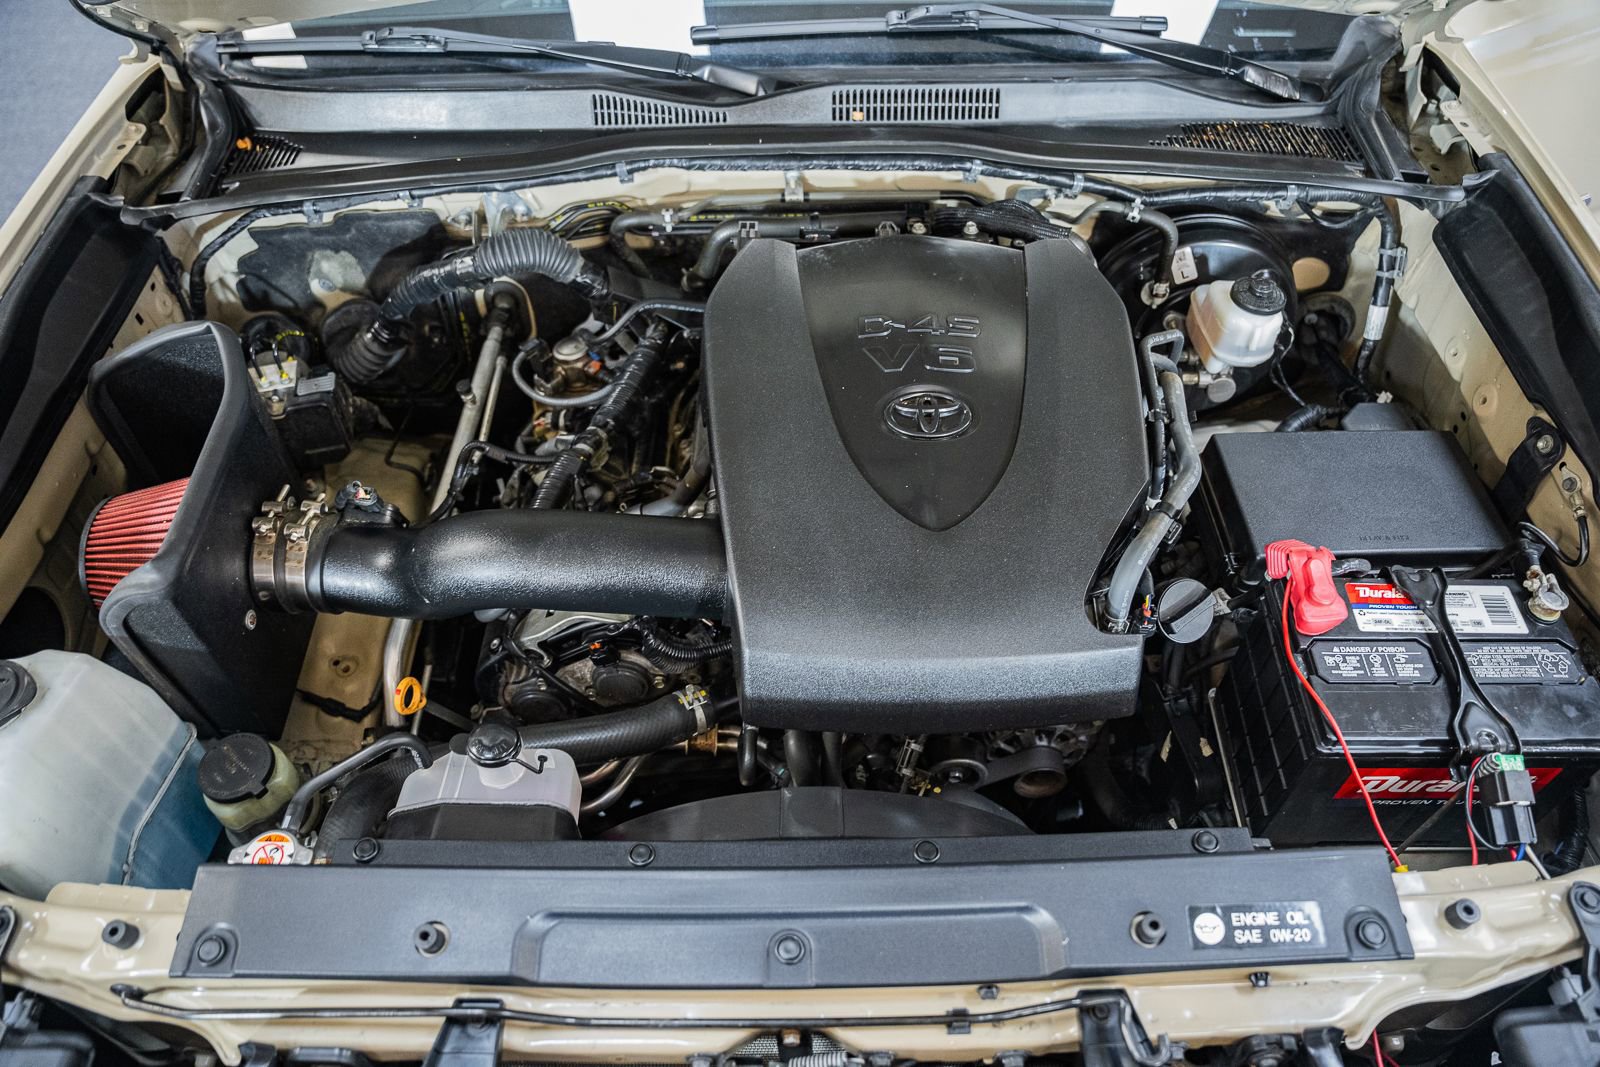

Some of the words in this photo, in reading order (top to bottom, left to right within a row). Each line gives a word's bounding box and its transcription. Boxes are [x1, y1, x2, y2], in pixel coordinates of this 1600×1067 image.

[858, 314, 981, 338] D-4S
[1231, 912, 1280, 926] ENGINE
[1286, 911, 1310, 925] OIL
[1234, 929, 1263, 943] SAE
[1270, 928, 1311, 942] 0W-20
